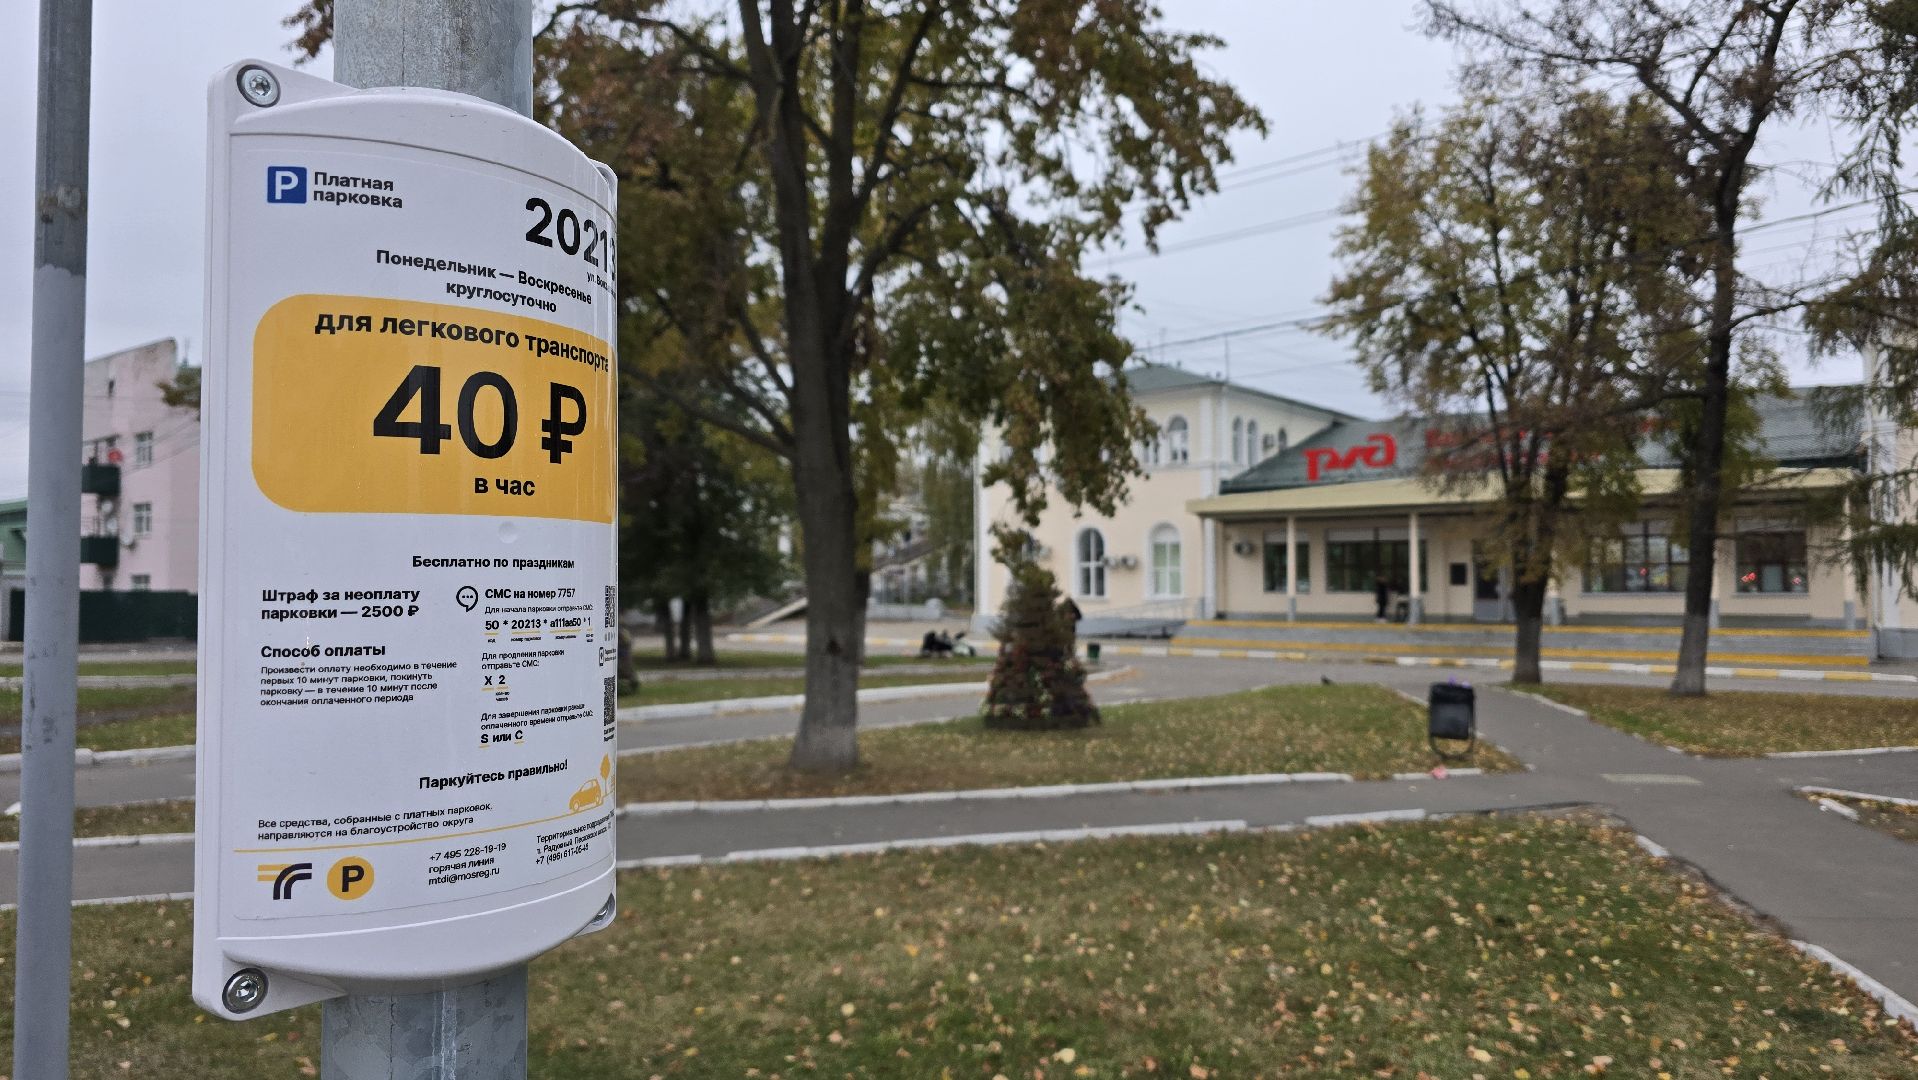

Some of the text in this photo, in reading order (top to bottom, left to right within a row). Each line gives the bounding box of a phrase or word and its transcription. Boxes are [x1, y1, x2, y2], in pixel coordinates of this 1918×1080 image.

[274, 170, 299, 200] P
[314, 171, 394, 191] Платная
[313, 190, 403, 208] парковка
[376, 249, 496, 279] Понедельник
[518, 270, 592, 304] Воскресенье
[446, 282, 557, 313] круглосуточно
[314, 313, 610, 373] для легкового транспорта
[373, 364, 587, 465] 40 ₽
[474, 477, 536, 496] в час
[412, 555, 575, 571] Бесплатно по праздникам
[262, 588, 421, 604] Штраф за неоплату
[485, 588, 576, 600] СМС на номер 7757
[261, 608, 337, 622] парковки
[361, 605, 404, 618] 2500
[407, 605, 420, 617] ₽
[484, 606, 500, 615] Для
[485, 620, 500, 630] 50
[511, 618, 542, 630] 20213
[260, 643, 386, 658] Способ оплаты
[482, 652, 497, 661] Для
[261, 666, 316, 675] Произвести
[317, 665, 351, 675] оплату
[353, 663, 412, 673] необходимо
[421, 661, 457, 670] течение
[521, 659, 540, 668] СМС:
[260, 673, 433, 686] первых 10 минут парковки, покинуть
[498, 674, 506, 685] 2
[260, 687, 303, 697] парковку
[325, 686, 365, 694] течение
[367, 684, 378, 692] 10
[380, 684, 409, 693] минут
[410, 682, 438, 691] после
[260, 694, 414, 706] окончания оплаченного периода
[480, 733, 489, 744] S
[492, 733, 512, 743] или
[419, 759, 568, 790] Паркуйтесь правильно!
[258, 819, 277, 828] Все
[279, 818, 331, 829] средства,
[333, 815, 392, 825] собранные
[394, 812, 401, 820] с
[403, 808, 445, 819] платных
[257, 816, 474, 841] направляются на благоустройство округа
[429, 852, 441, 861] +7
[443, 849, 462, 860] 495
[535, 855, 545, 865] +7
[428, 857, 495, 874] горячая линия
[428, 867, 500, 886] mtdi@mosreg.ru
